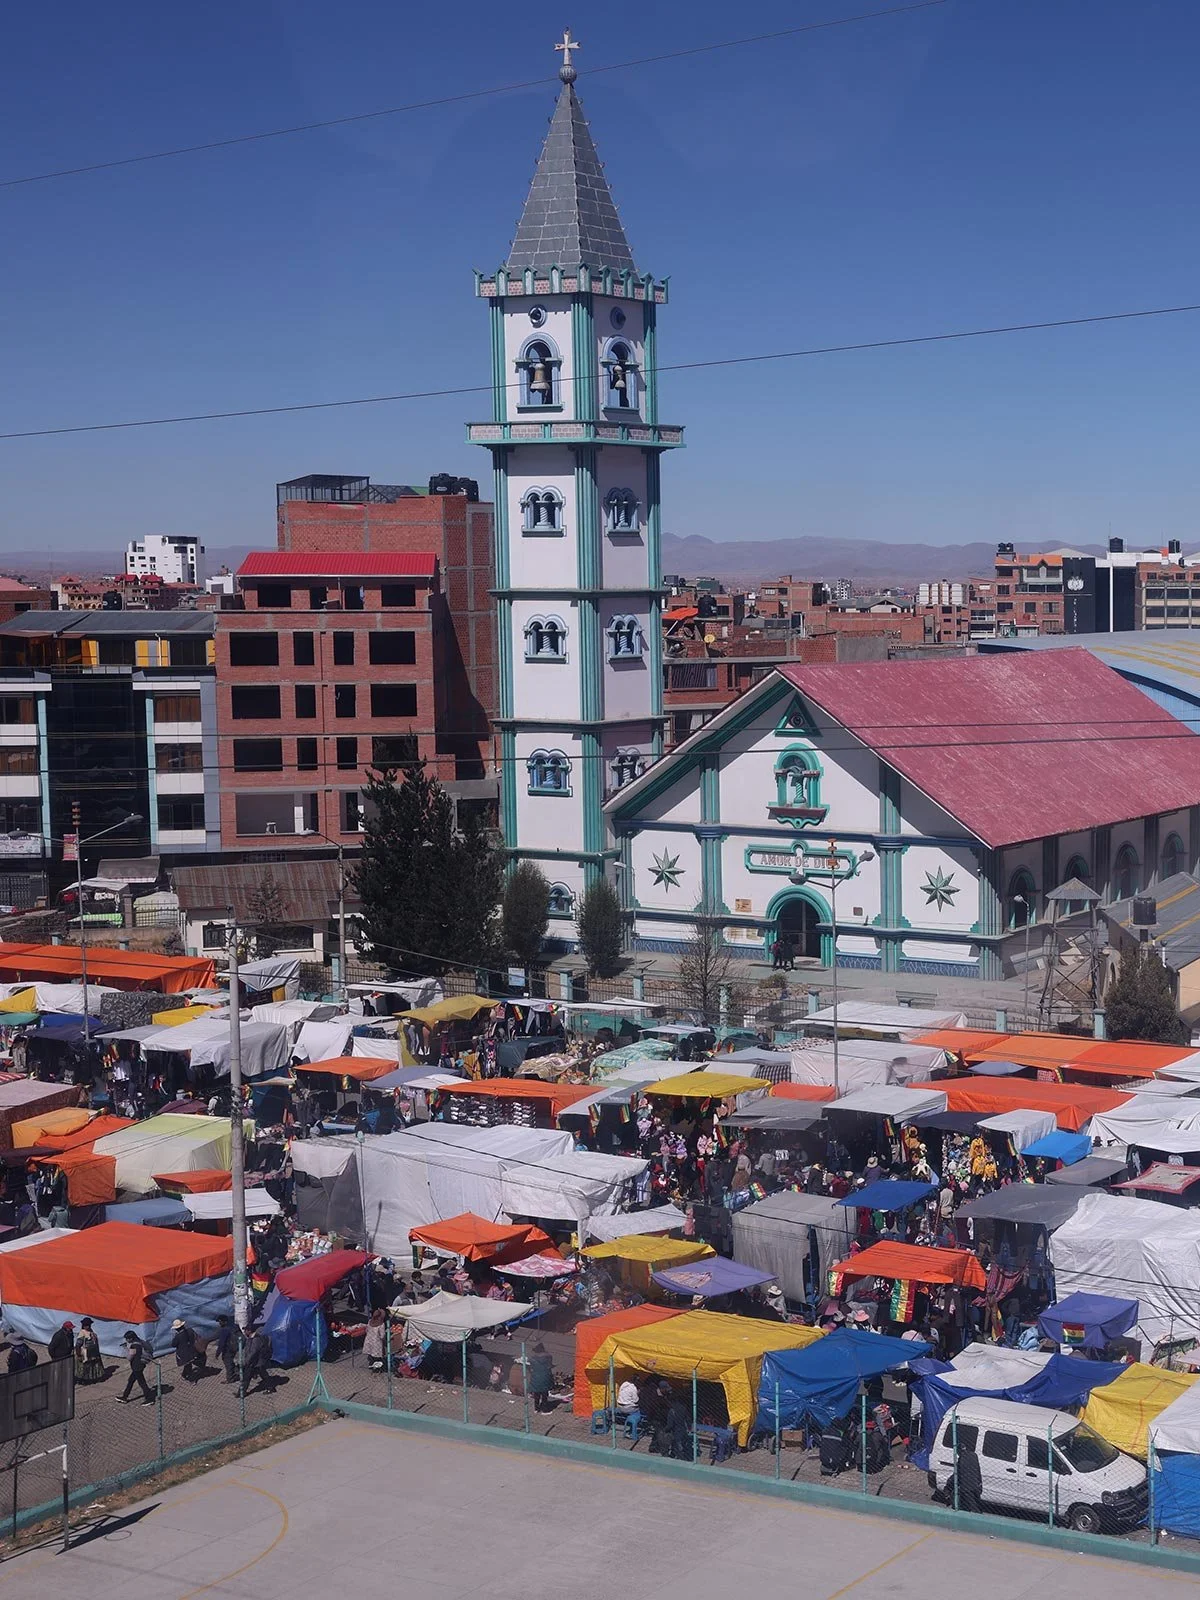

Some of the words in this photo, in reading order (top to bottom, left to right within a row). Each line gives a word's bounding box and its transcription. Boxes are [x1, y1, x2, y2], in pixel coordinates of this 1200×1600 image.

[760, 853, 792, 867] AMOR
[795, 856, 810, 868] DE
[813, 857, 841, 870] DIS
